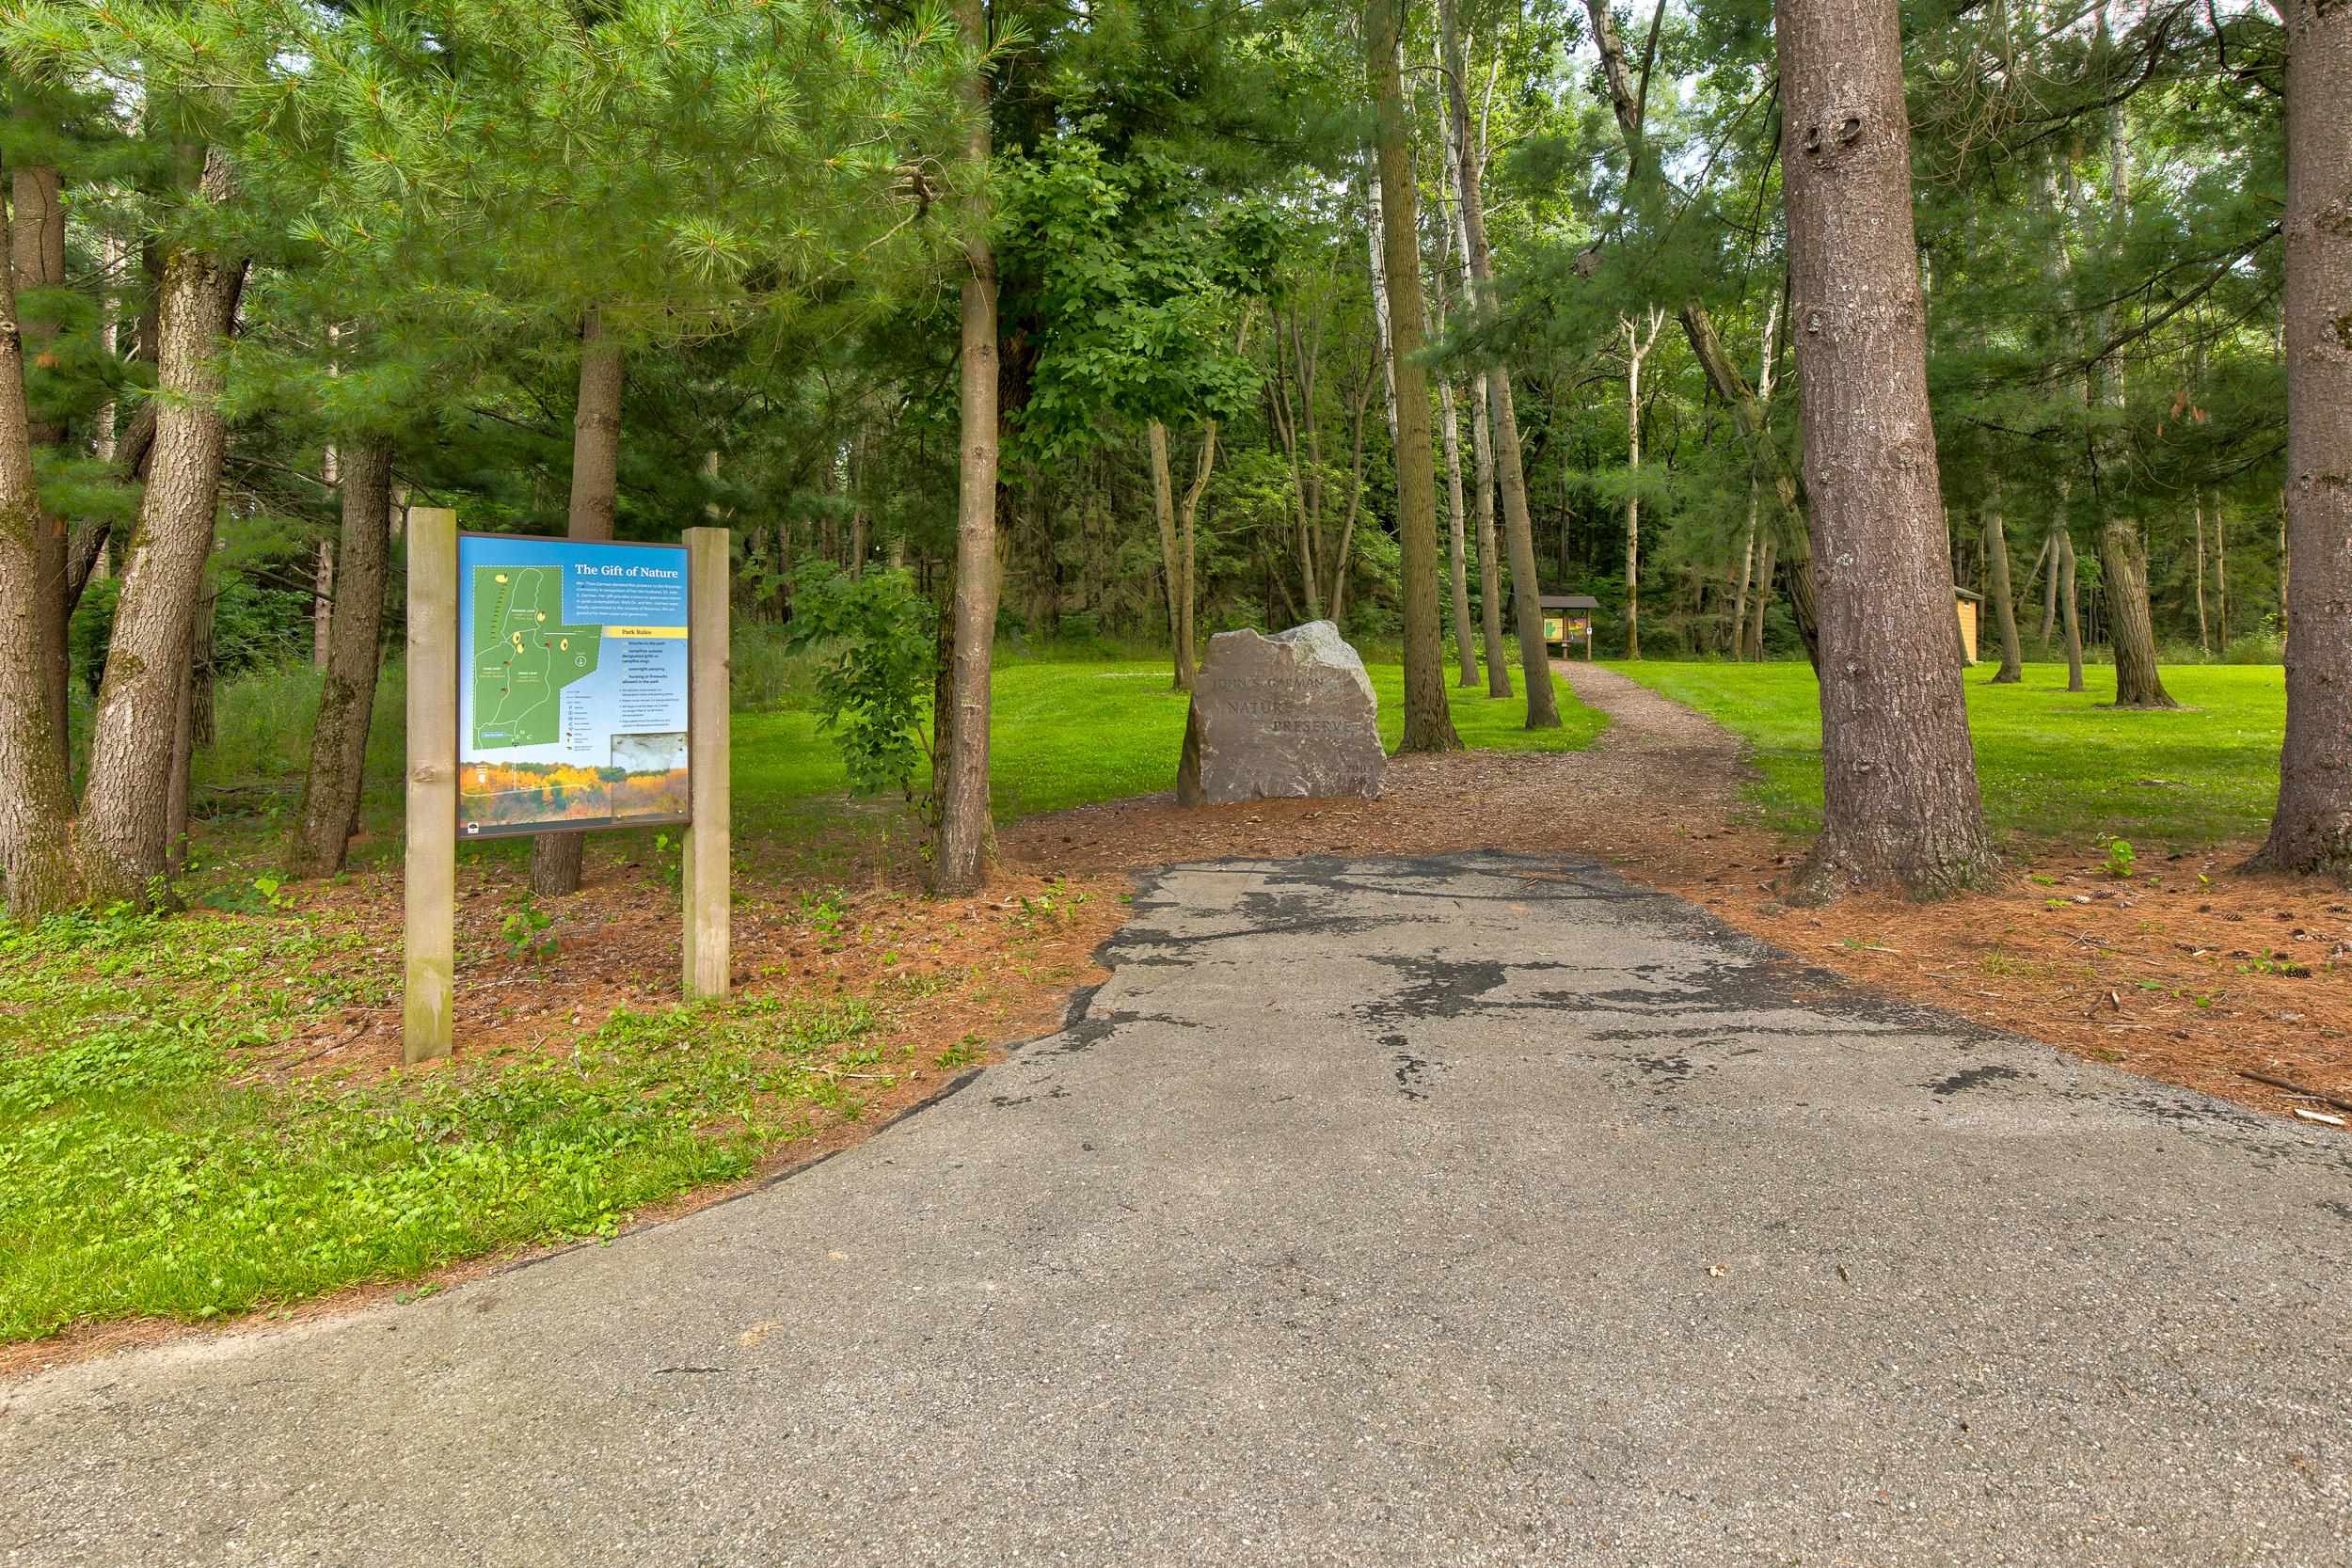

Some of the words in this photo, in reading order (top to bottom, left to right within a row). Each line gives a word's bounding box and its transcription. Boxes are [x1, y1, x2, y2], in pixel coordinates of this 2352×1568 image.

[574, 563, 597, 576] The
[601, 564, 623, 577] Gift
[626, 566, 639, 577] of
[640, 567, 678, 578] Nature
[1272, 721, 1354, 732] PRESERVE
